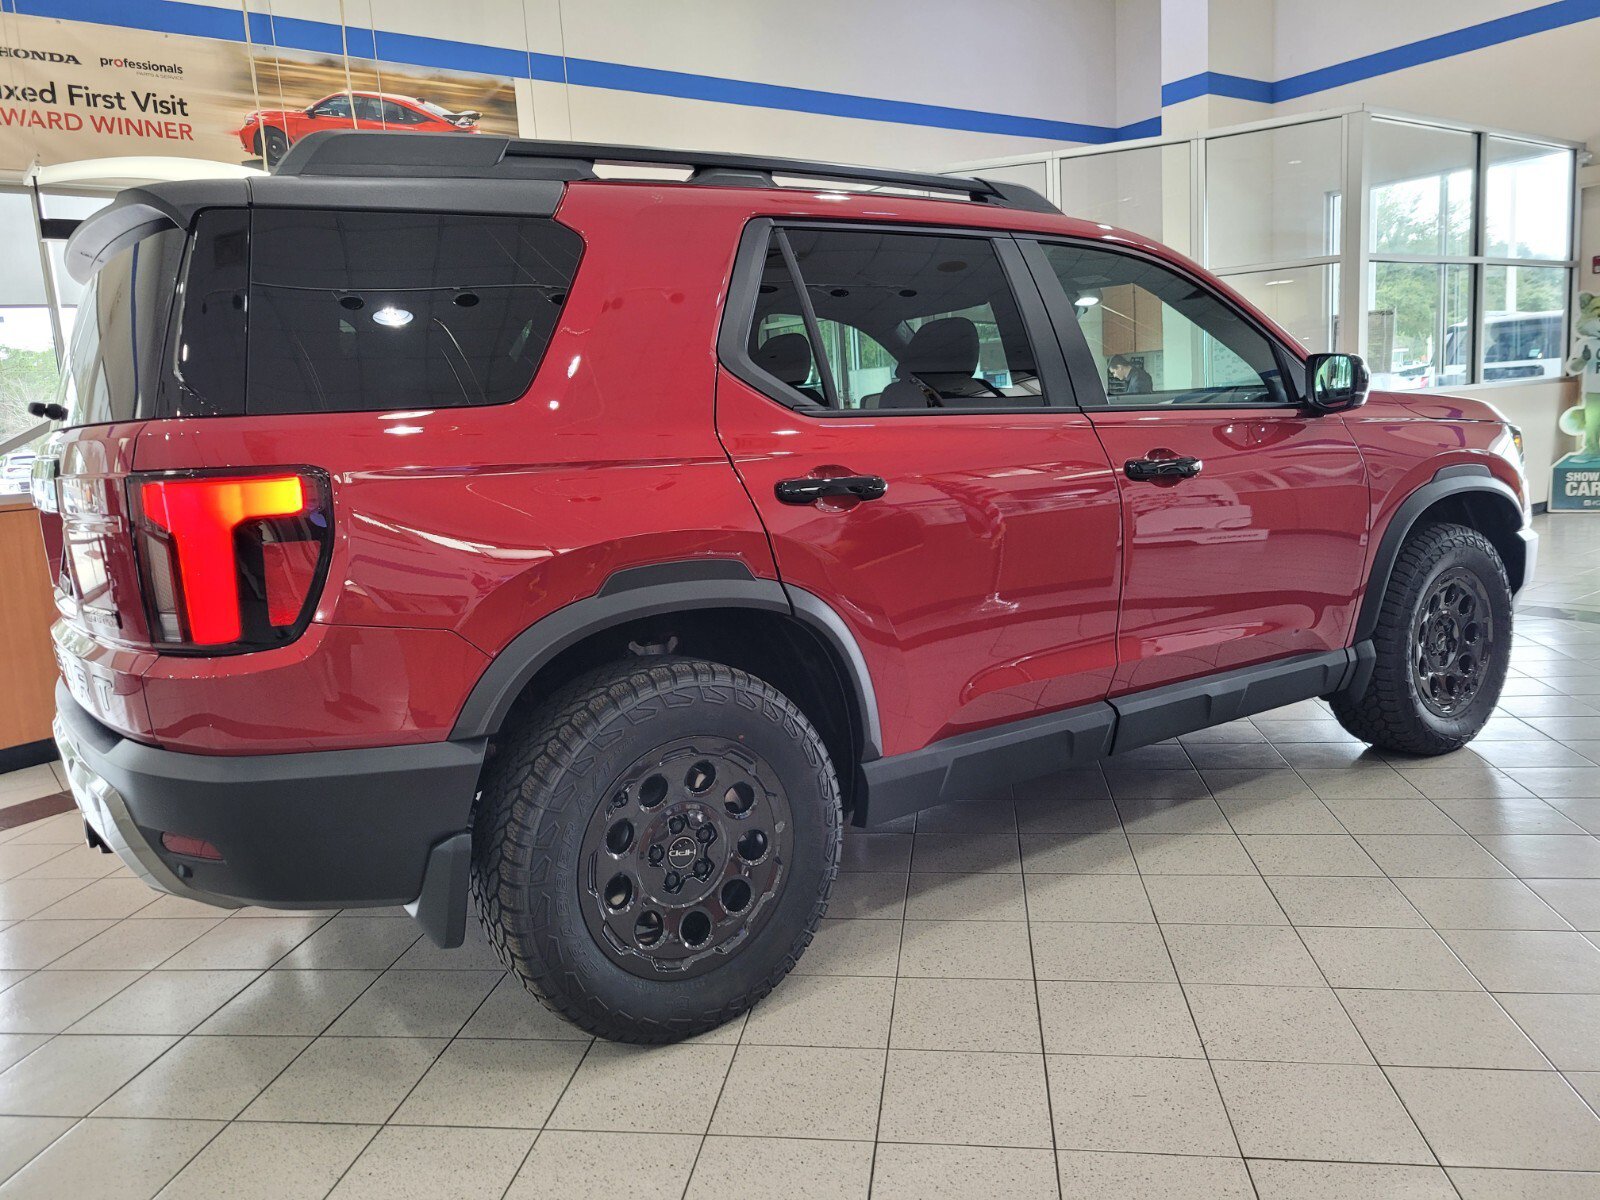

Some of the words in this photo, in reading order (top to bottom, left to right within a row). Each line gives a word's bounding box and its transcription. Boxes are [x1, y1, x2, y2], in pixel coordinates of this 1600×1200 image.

[0, 47, 82, 65] HONDA
[100, 57, 183, 75] professionals
[67, 84, 127, 111] First
[131, 90, 189, 117] Visit
[0, 107, 83, 131] WARD
[89, 114, 194, 141] WINNER
[1565, 472, 1600, 482] SHOW
